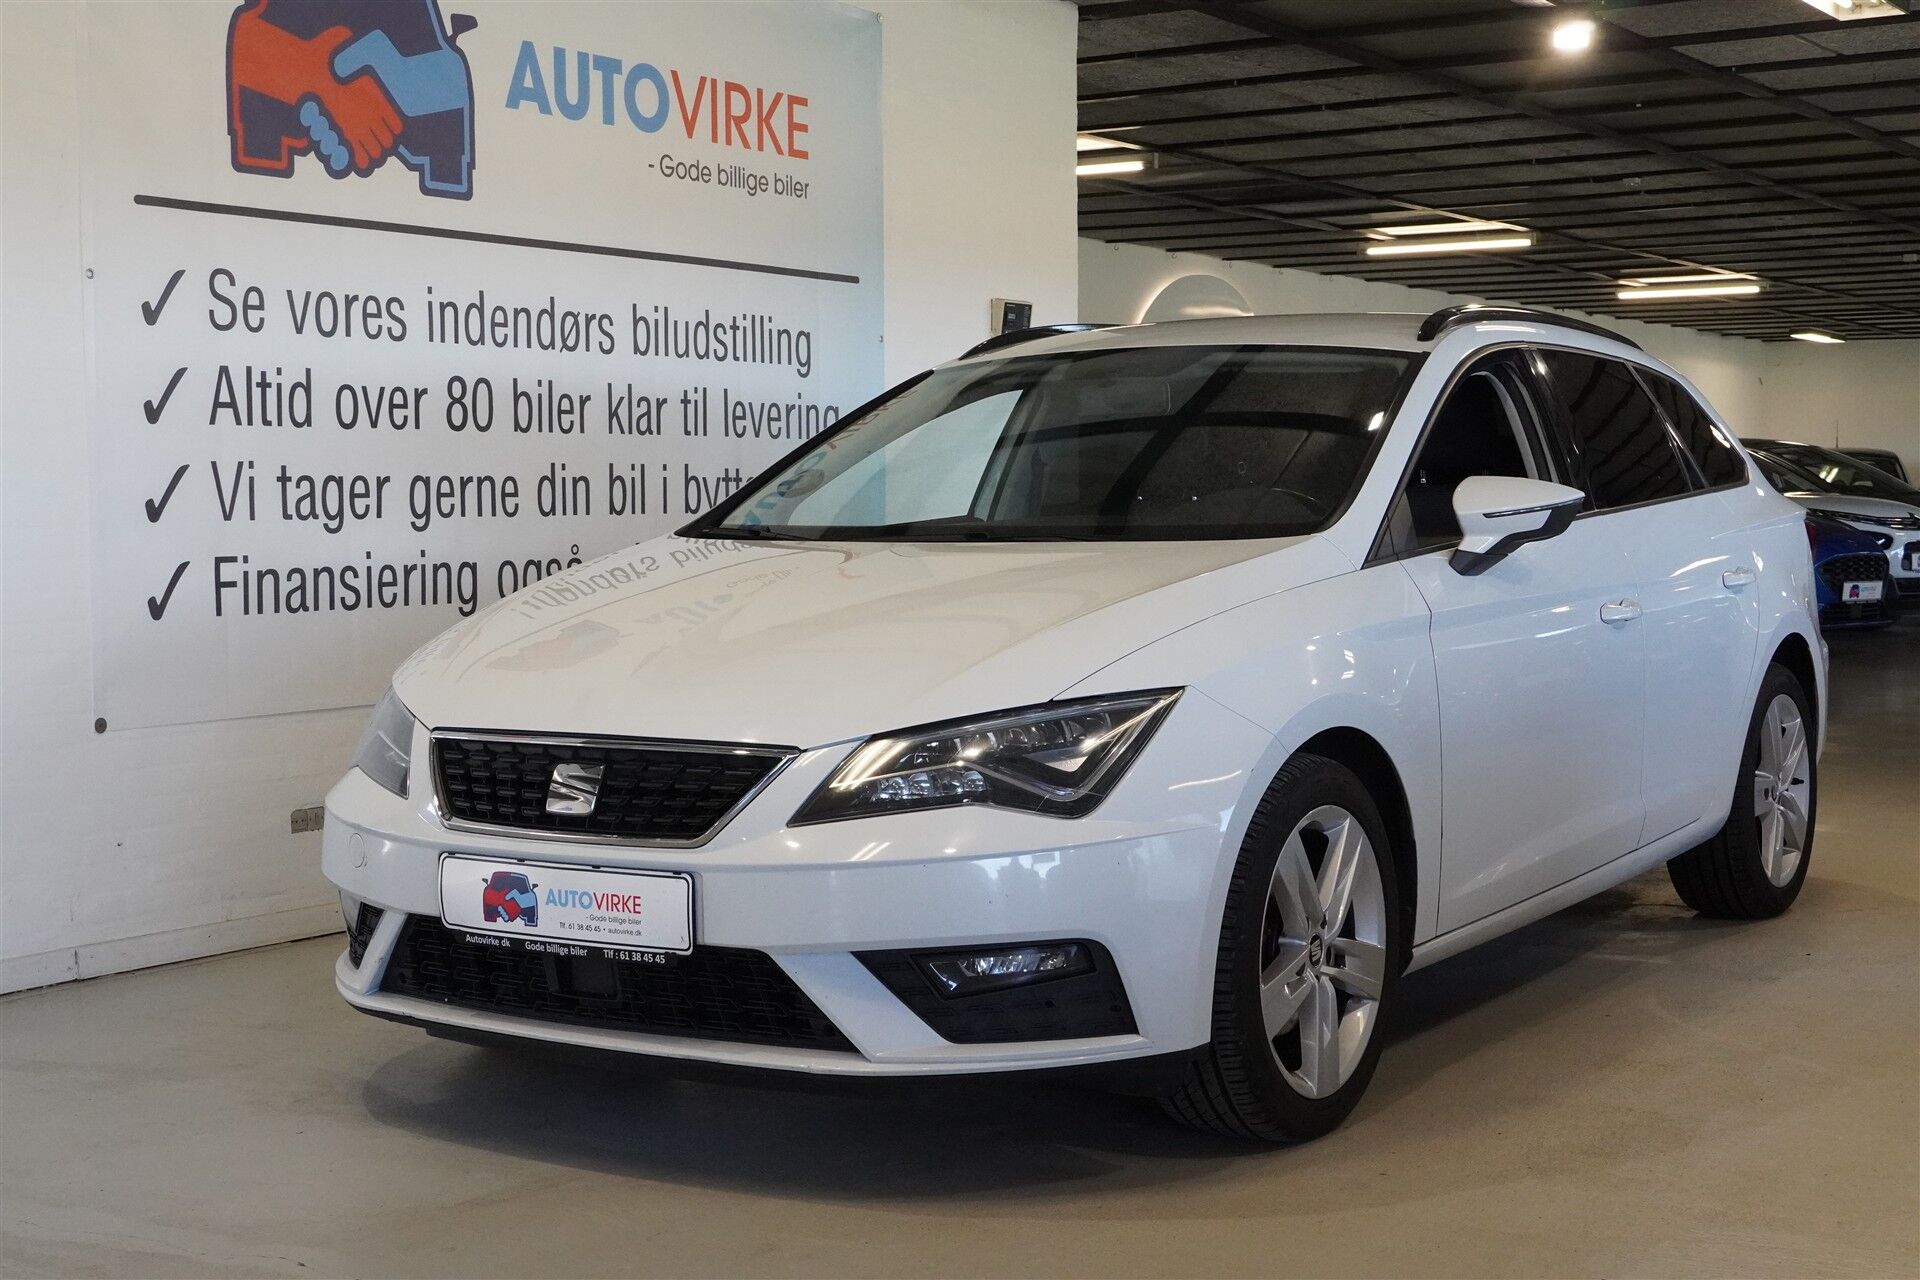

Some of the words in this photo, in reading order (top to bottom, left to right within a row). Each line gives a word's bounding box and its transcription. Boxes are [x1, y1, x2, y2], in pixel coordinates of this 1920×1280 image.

[505, 40, 809, 160] AUTOVIRKE
[660, 153, 712, 184] Gode
[717, 162, 769, 197] billige
[774, 172, 810, 200] biler
[209, 267, 265, 334] Se
[286, 289, 408, 343] vores
[427, 285, 616, 356] indendørs
[632, 302, 812, 379] biludstilling
[209, 365, 313, 429] Altid
[336, 383, 429, 431] over
[446, 375, 494, 434] 80
[513, 377, 592, 435] biler
[608, 382, 668, 437] klar
[680, 386, 708, 438] til
[211, 460, 256, 522] Vi
[276, 464, 391, 535] tager
[409, 474, 520, 533] gerne
[537, 462, 591, 518] din
[608, 462, 646, 517] bil
[662, 463, 668, 515] i
[684, 463, 755, 515] bytt
[214, 549, 478, 618] Finansiering
[545, 888, 641, 914] AUTOVIRKE
[576, 923, 584, 931] 38
[594, 925, 601, 933] 45
[608, 927, 643, 937] autovirke.dk
[589, 913, 607, 923] Gode
[608, 916, 627, 926] billige
[628, 917, 642, 926] biler
[465, 933, 500, 946] Autovirke
[501, 937, 511, 947] dk
[525, 941, 545, 951] Gode
[546, 943, 569, 955] billige
[570, 945, 588, 956] biler
[620, 951, 630, 960] 61
[631, 952, 642, 962] 38
[643, 953, 653, 963] 45
[655, 954, 665, 964] 45
